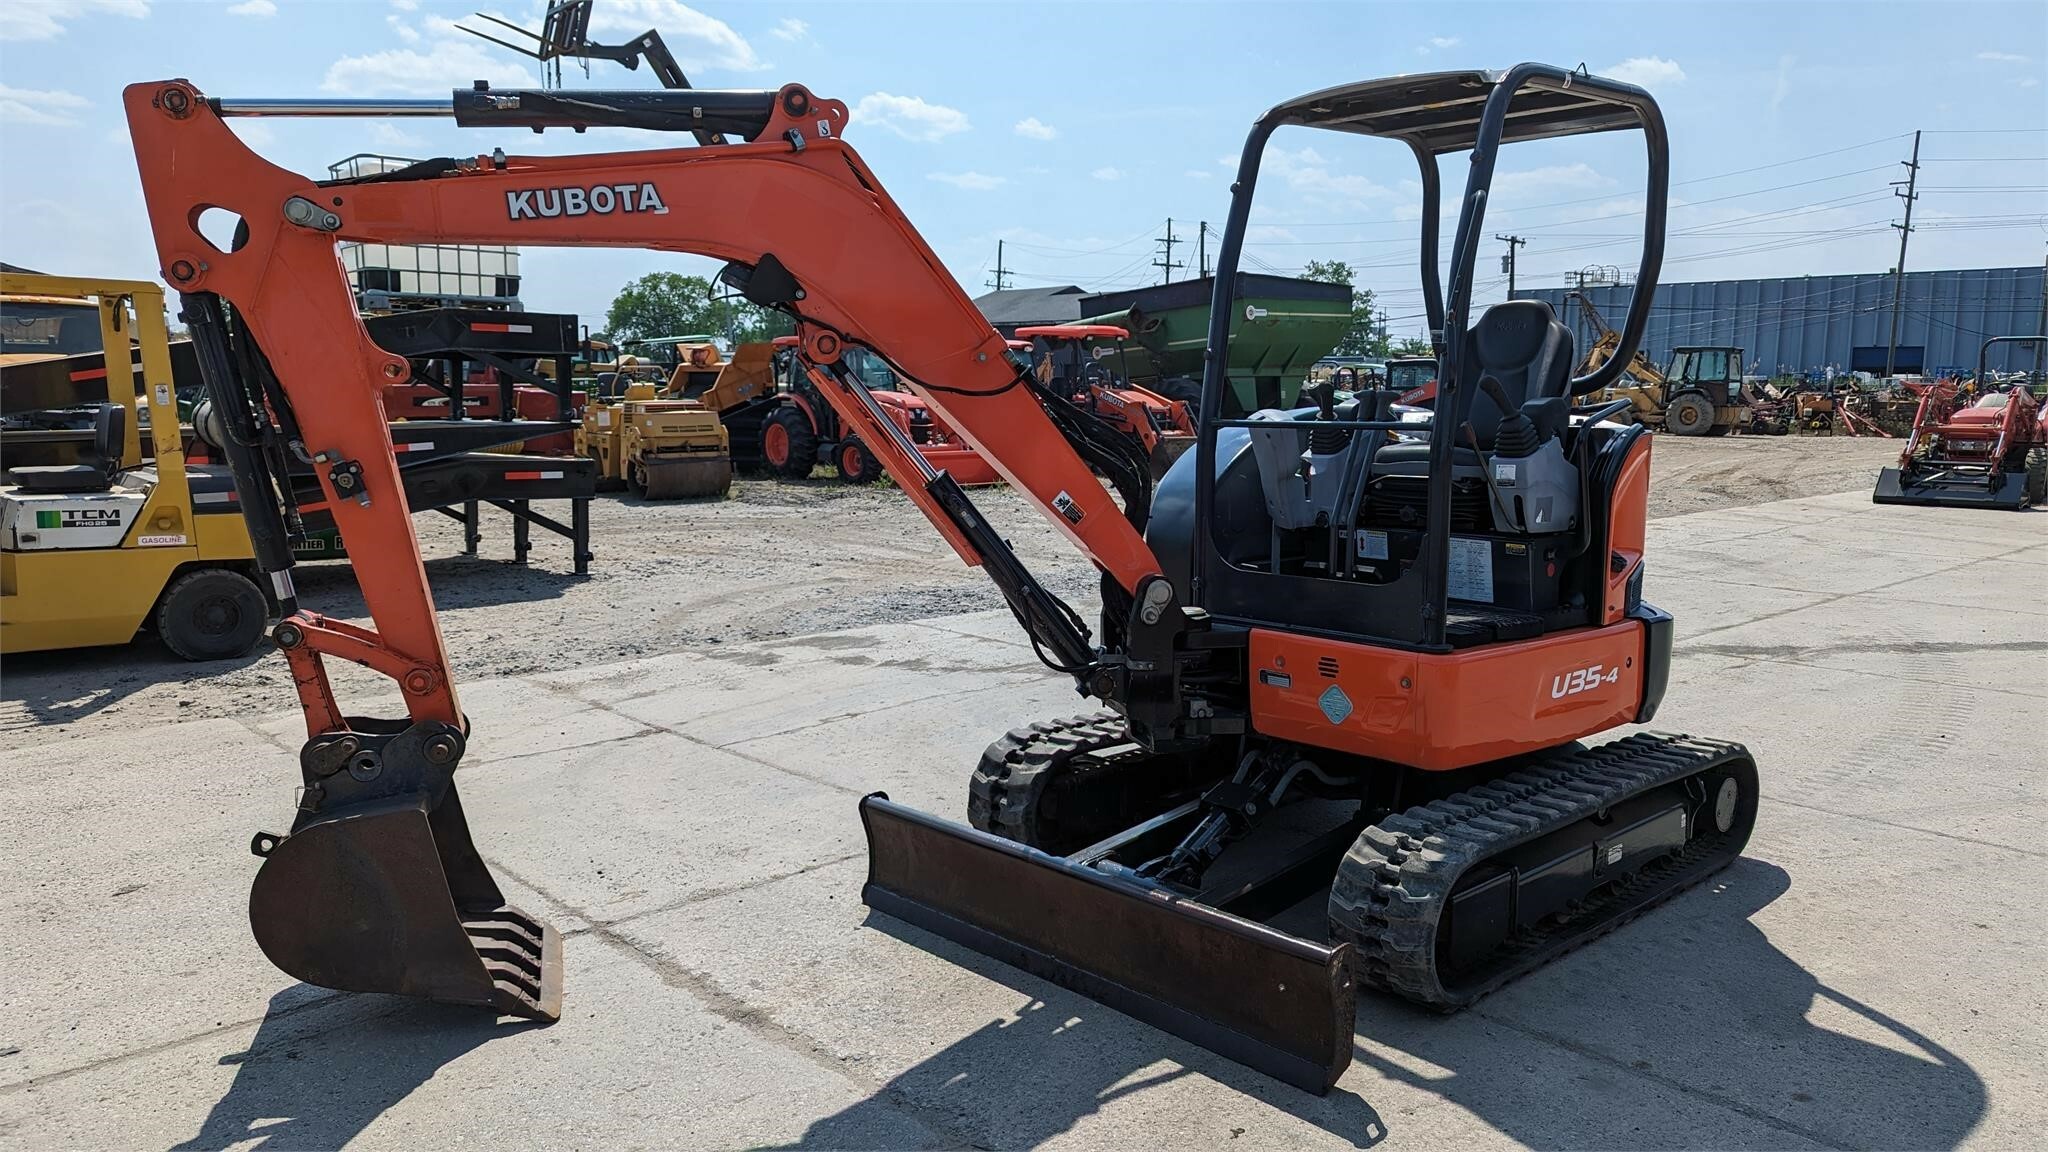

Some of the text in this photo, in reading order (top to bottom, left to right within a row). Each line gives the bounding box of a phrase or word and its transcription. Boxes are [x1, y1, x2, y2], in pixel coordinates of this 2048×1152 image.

[506, 183, 665, 219] KUBOTA
[1099, 391, 1124, 408] KUBOTA
[62, 510, 120, 519] TCM
[141, 536, 183, 544] GASOLINE
[1551, 664, 1619, 699] U35-4
